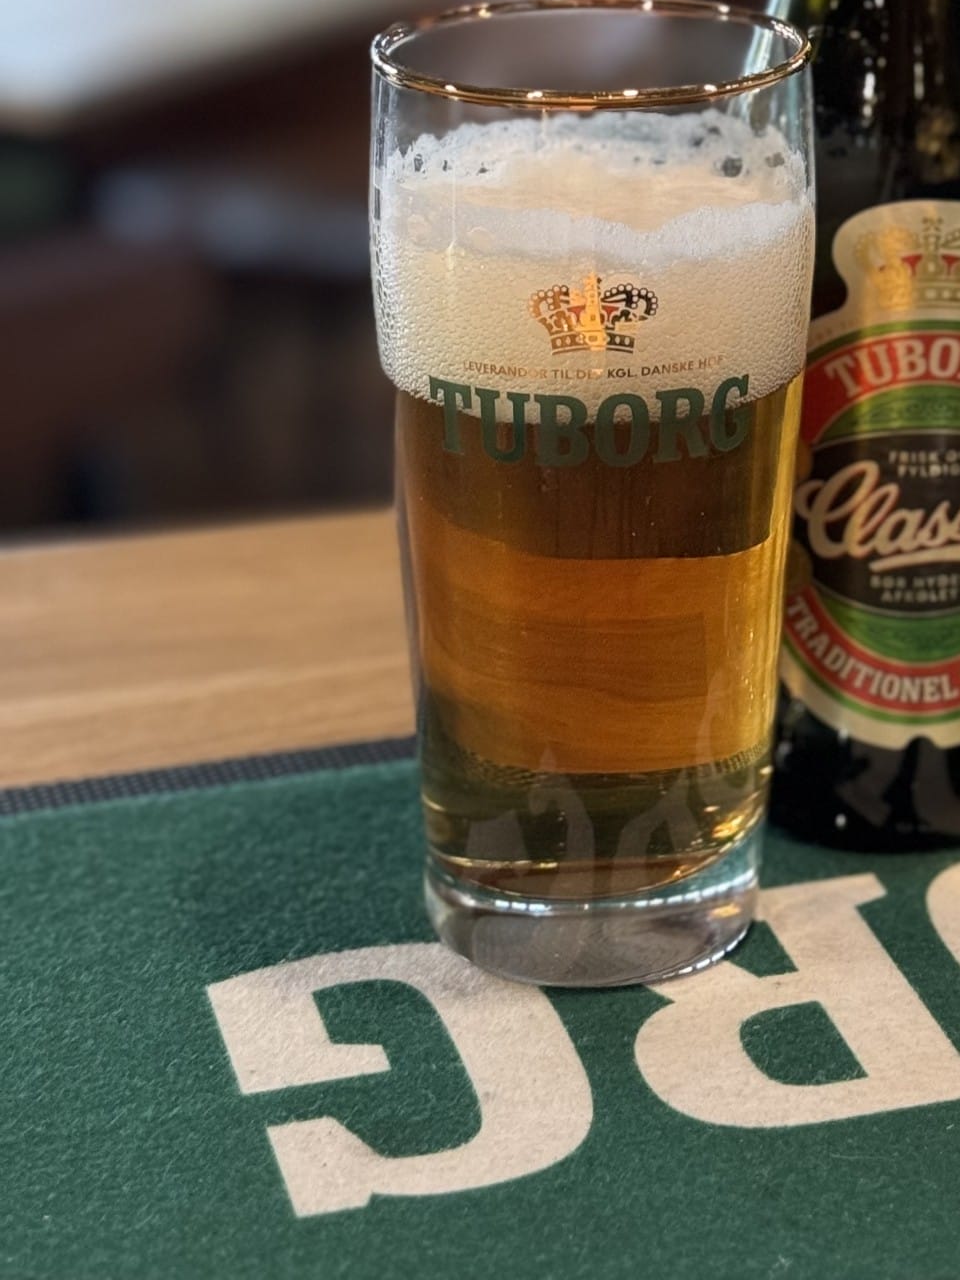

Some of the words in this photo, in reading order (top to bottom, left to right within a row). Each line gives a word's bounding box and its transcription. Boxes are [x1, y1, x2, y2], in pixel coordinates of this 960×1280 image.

[552, 369, 570, 380] TIL
[607, 368, 637, 379] KGL.
[641, 361, 694, 377] DANSKE
[428, 373, 750, 468] TUBORG
[788, 595, 960, 703] TRADITIONEL
